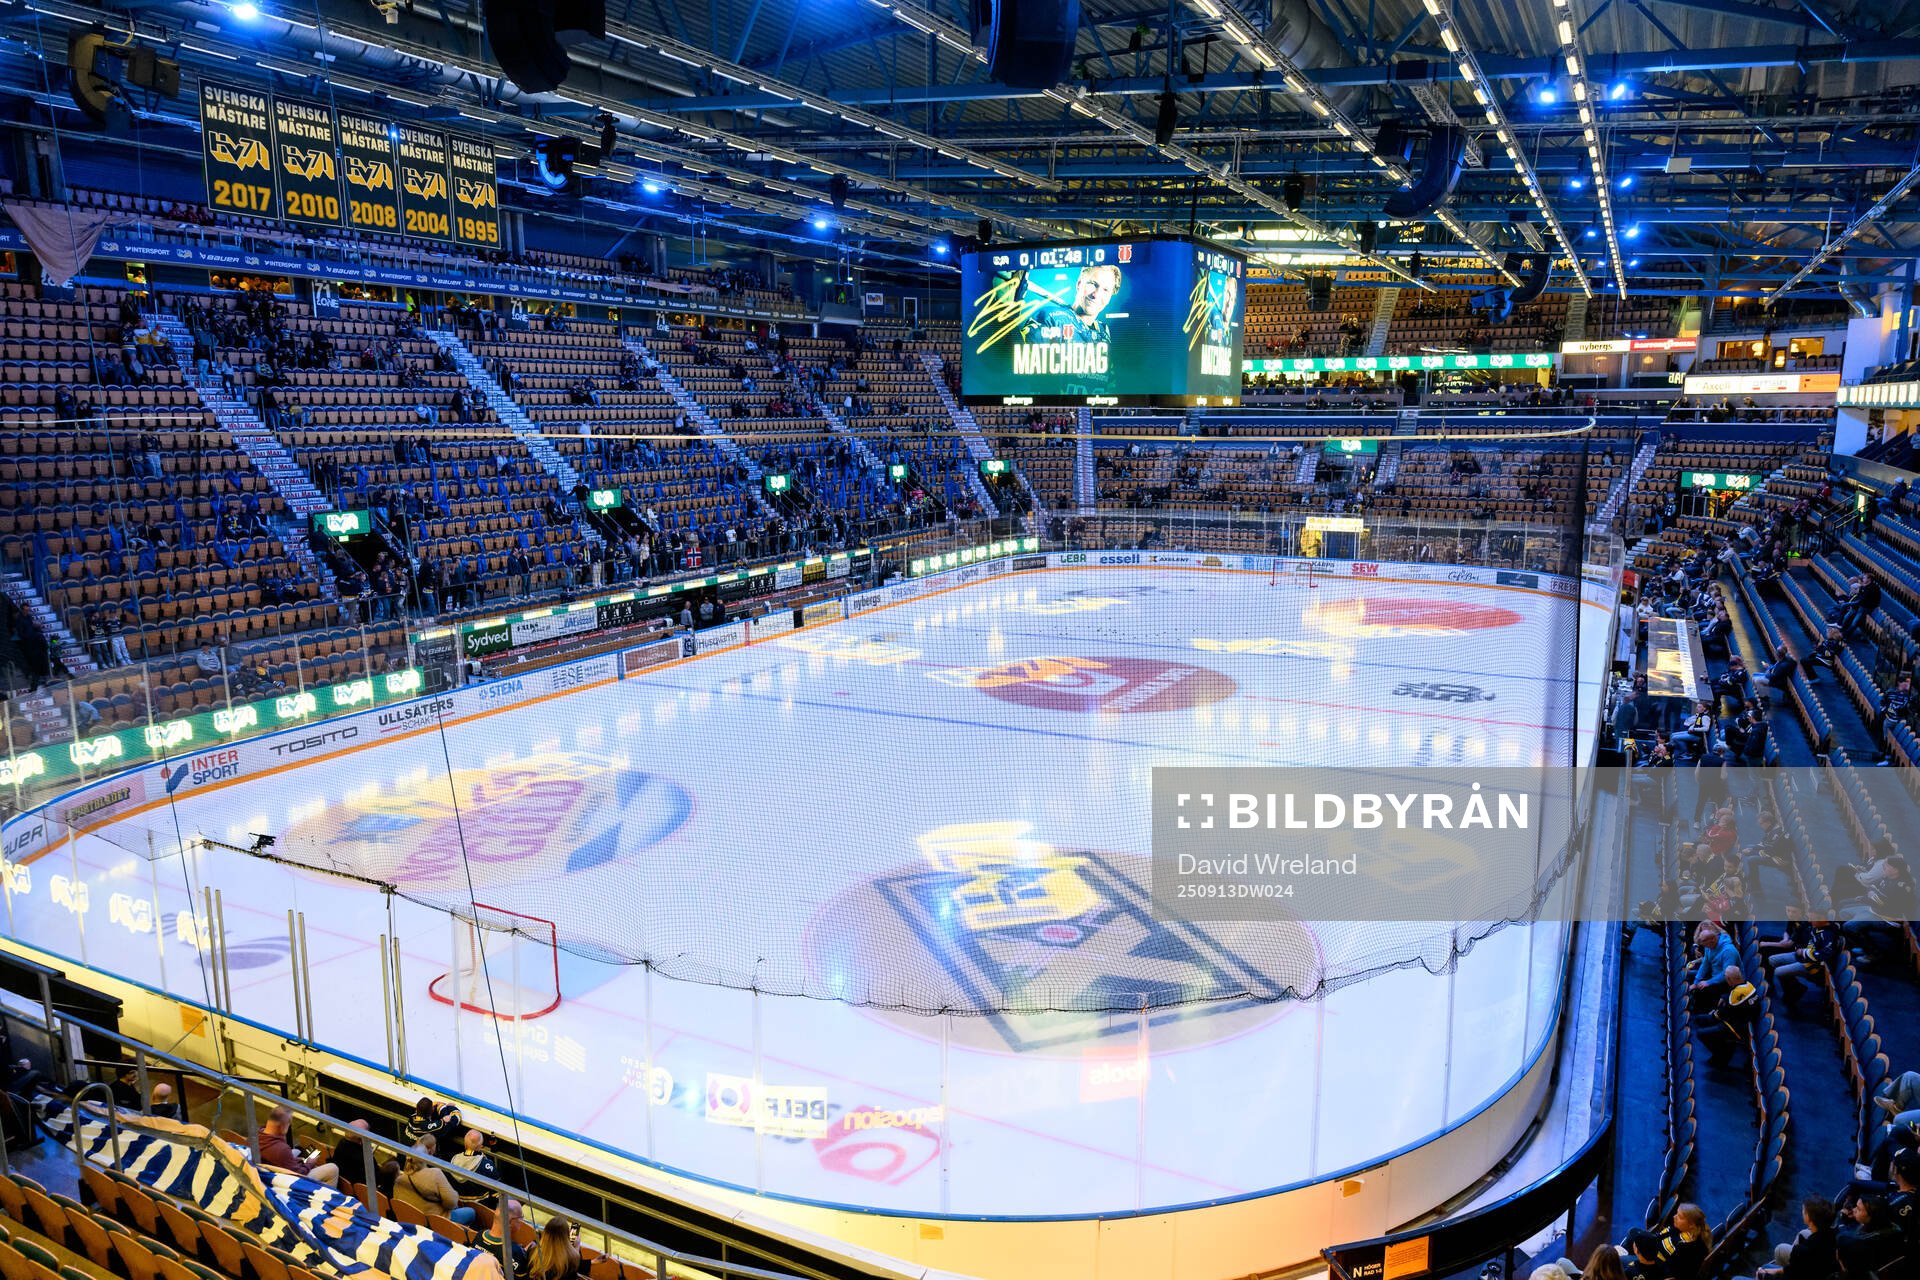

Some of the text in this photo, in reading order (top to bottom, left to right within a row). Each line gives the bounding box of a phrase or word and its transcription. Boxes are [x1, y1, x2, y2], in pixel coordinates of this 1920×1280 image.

[205, 86, 265, 112] SVENSKA
[206, 104, 266, 130] MÄSTARE
[276, 102, 329, 125] SVENSKA
[278, 118, 331, 142] MÄSTARE
[340, 115, 389, 137] SVENSKA
[342, 131, 390, 153] MÄSTARE
[399, 128, 443, 148] SVENSKA
[400, 143, 445, 164] MÄSTARE
[452, 139, 493, 160] SVENSKA
[453, 153, 494, 174] MÄSTARE
[213, 180, 271, 212] 2017
[286, 191, 339, 220] 2010
[351, 200, 397, 228] 2008
[405, 209, 449, 236] 2004
[457, 217, 498, 243] 1995
[1579, 342, 1612, 351] nybergs
[1014, 342, 1108, 374] MATCHDAG
[1100, 554, 1140, 564] essell
[1351, 563, 1379, 572] SEW
[854, 593, 881, 610] nybergs
[467, 628, 509, 652] Sydved
[698, 632, 737, 649] Husqvarna
[490, 679, 524, 699] STENA
[379, 698, 454, 726] ULLSÄTERS
[270, 726, 357, 755] TOSITO
[192, 750, 238, 771] INTER
[193, 763, 239, 785] SPORT
[1353, 1267, 1362, 1278] N
